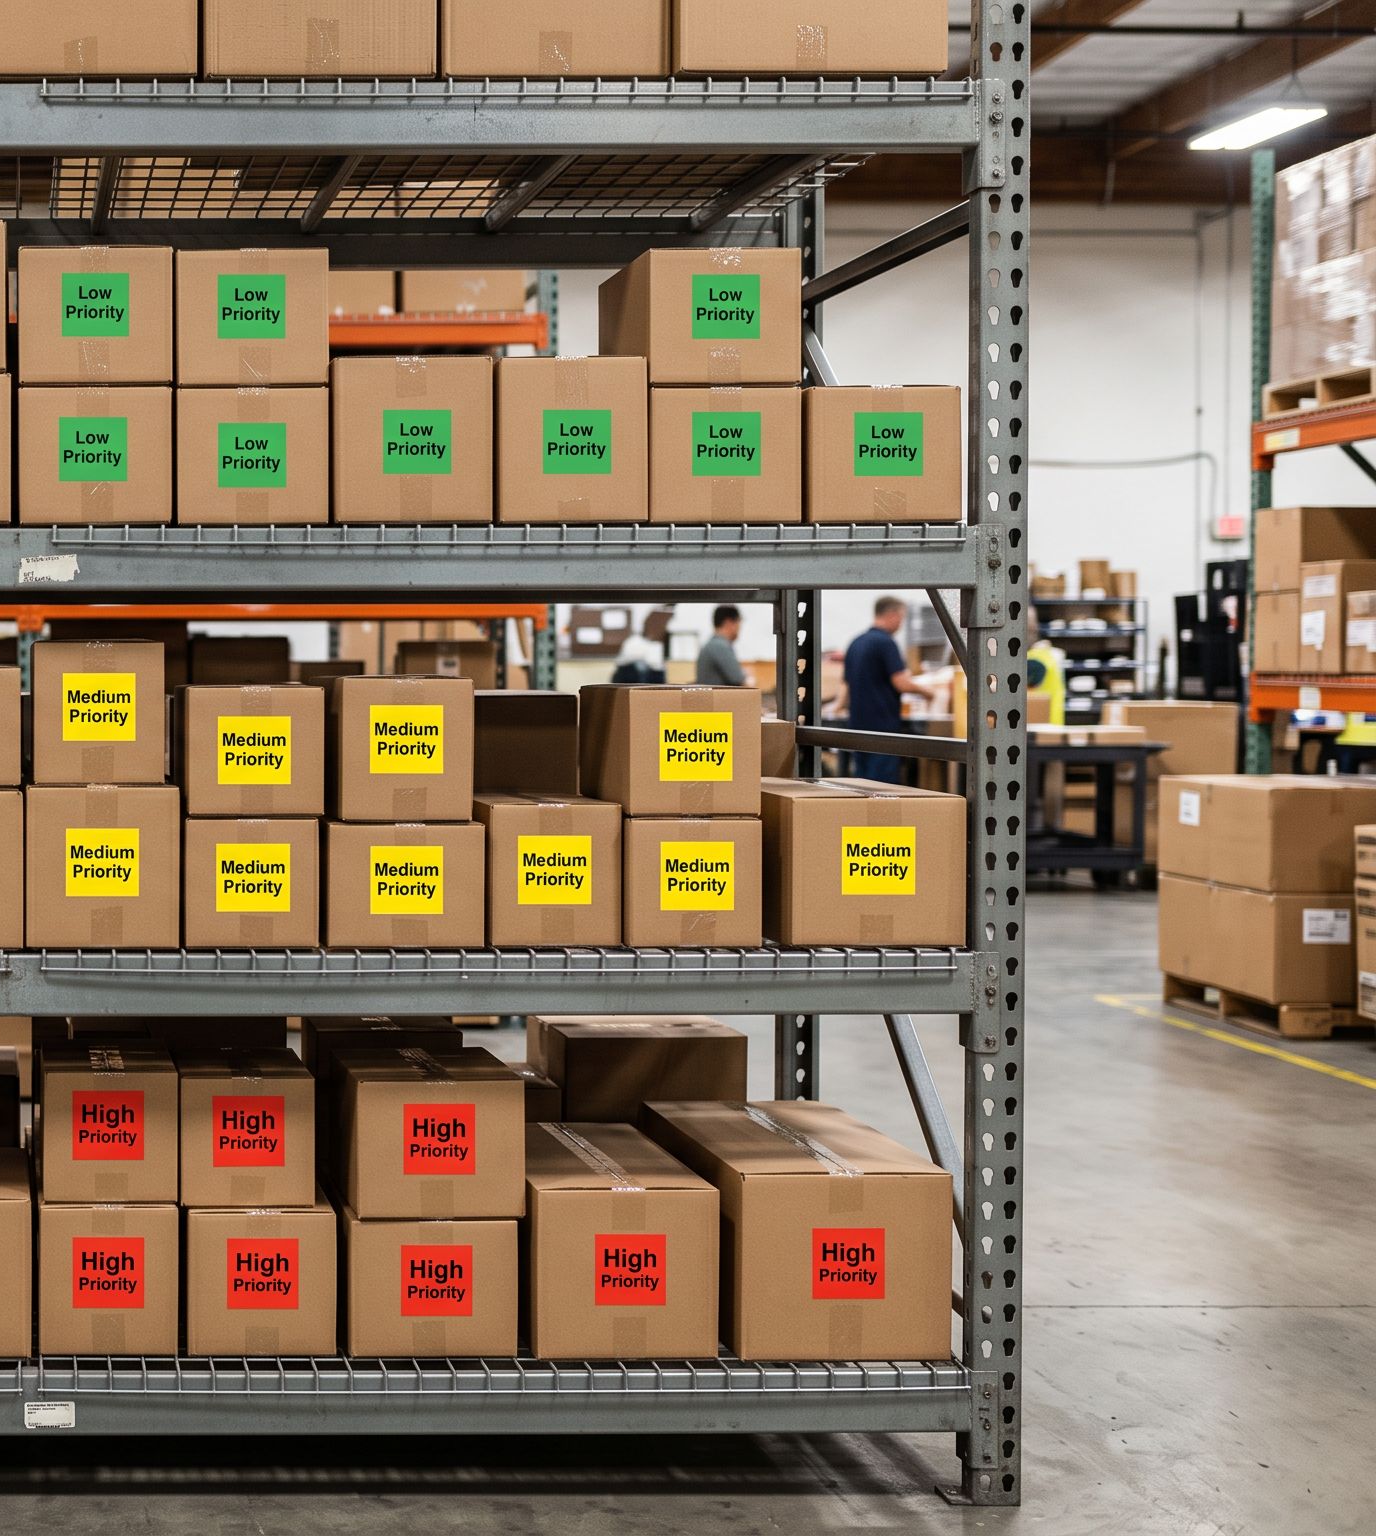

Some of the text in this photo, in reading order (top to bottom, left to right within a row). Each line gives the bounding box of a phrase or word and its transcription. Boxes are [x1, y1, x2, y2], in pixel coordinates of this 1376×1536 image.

[78, 285, 113, 300] Low
[234, 287, 269, 302] Low
[709, 287, 743, 302] Low
[65, 304, 125, 323] Priority
[222, 306, 281, 325] Priority
[696, 306, 755, 325] Priority
[75, 430, 110, 445] Low
[400, 422, 434, 437] Low
[560, 422, 594, 437] Low
[709, 424, 743, 439] Low
[871, 425, 905, 440] Low
[234, 436, 269, 451] Low
[387, 441, 447, 460] Priority
[547, 441, 607, 460] Priority
[696, 443, 756, 462] Priority
[63, 449, 122, 467] Priority
[858, 444, 918, 462] Priority
[222, 455, 281, 473] Priority
[67, 689, 131, 704] Medium
[69, 708, 129, 727] Priority
[374, 721, 439, 737] Medium
[664, 728, 729, 743] Medium
[222, 732, 287, 747] Medium
[377, 741, 436, 759] Priority
[666, 747, 726, 767] Priority
[225, 751, 284, 770] Priority
[70, 844, 135, 860] Medium
[846, 842, 911, 858] Medium
[221, 859, 286, 875] Medium
[522, 852, 587, 867] Medium
[665, 858, 730, 873] Medium
[73, 863, 132, 883] Priority
[374, 862, 439, 877] Medium
[849, 862, 909, 881] Priority
[223, 879, 283, 898] Priority
[525, 871, 585, 890] Priority
[667, 877, 727, 896] Priority
[377, 881, 436, 900] Priority
[81, 1103, 135, 1129] High
[221, 1109, 275, 1135] High
[78, 1129, 137, 1147] Priority
[412, 1117, 466, 1143] High
[219, 1135, 278, 1153] Priority
[410, 1143, 469, 1161] Priority
[81, 1251, 135, 1276] High
[604, 1248, 657, 1274] High
[822, 1242, 875, 1268] High
[236, 1252, 289, 1278] High
[410, 1259, 463, 1285] High
[79, 1276, 138, 1294] Priority
[601, 1273, 660, 1292] Priority
[819, 1268, 878, 1286] Priority
[233, 1278, 292, 1296] Priority
[407, 1285, 466, 1303] Priority
